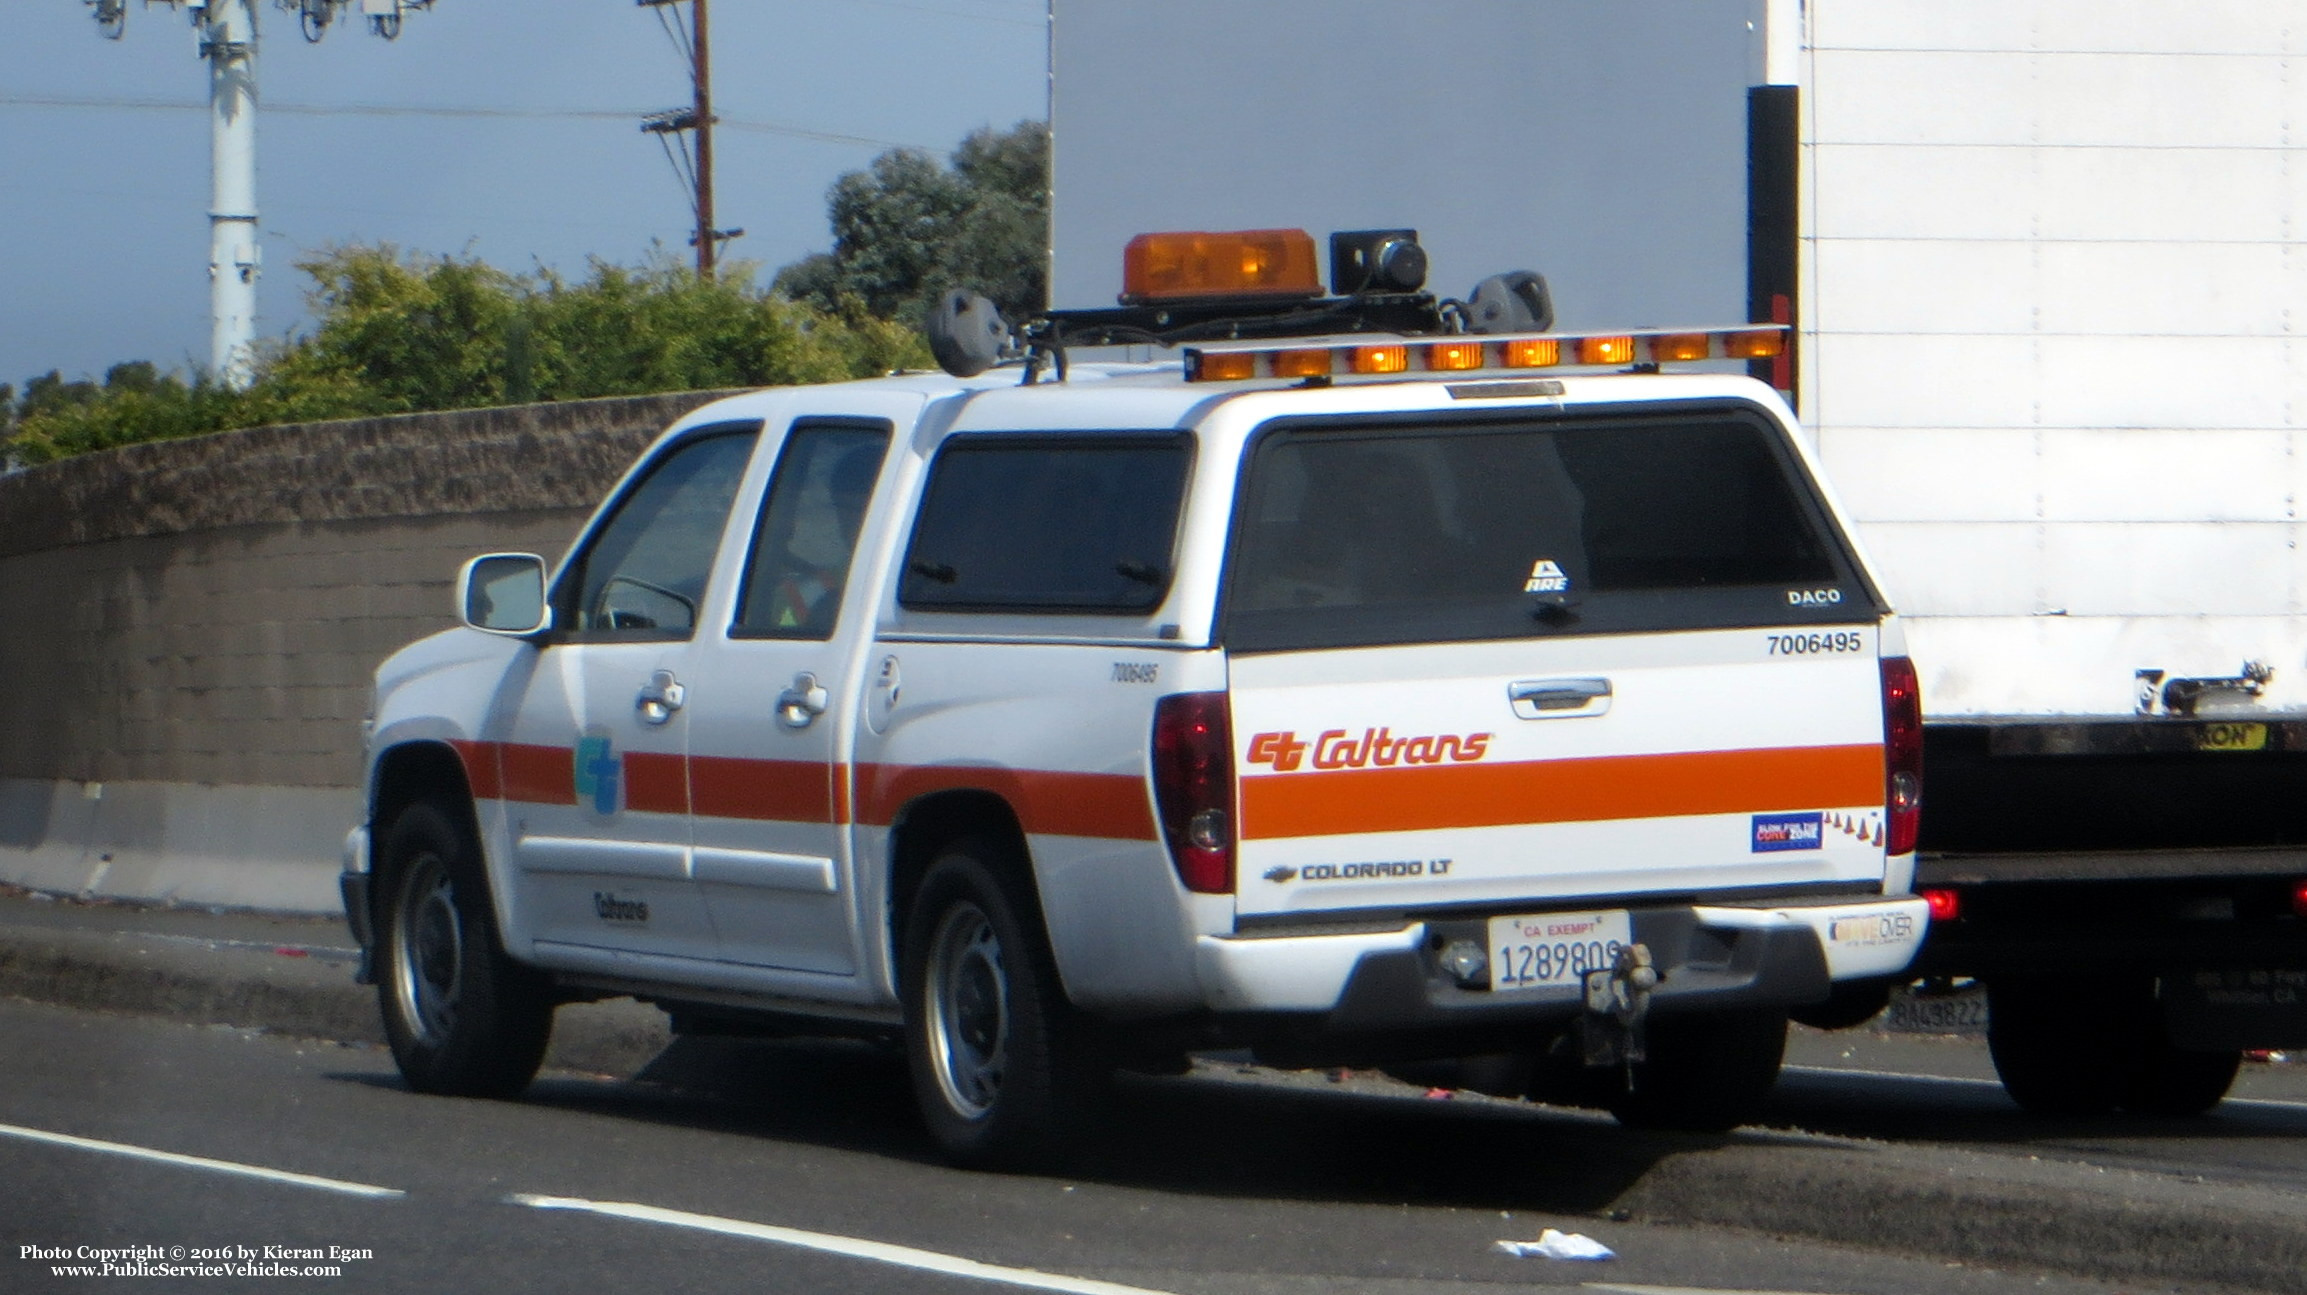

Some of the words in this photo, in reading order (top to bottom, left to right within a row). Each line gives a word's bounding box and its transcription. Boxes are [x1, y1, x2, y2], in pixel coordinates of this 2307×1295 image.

[1787, 588, 1841, 605] DACO
[1767, 631, 1861, 656] 7006495
[1312, 727, 1494, 770] Caltrans
[1302, 861, 1422, 880] COLORADO
[1430, 860, 1452, 875] LT
[1524, 926, 1541, 938] CA
[1548, 922, 1595, 936] EXEMPT
[1880, 916, 1912, 938] OVER
